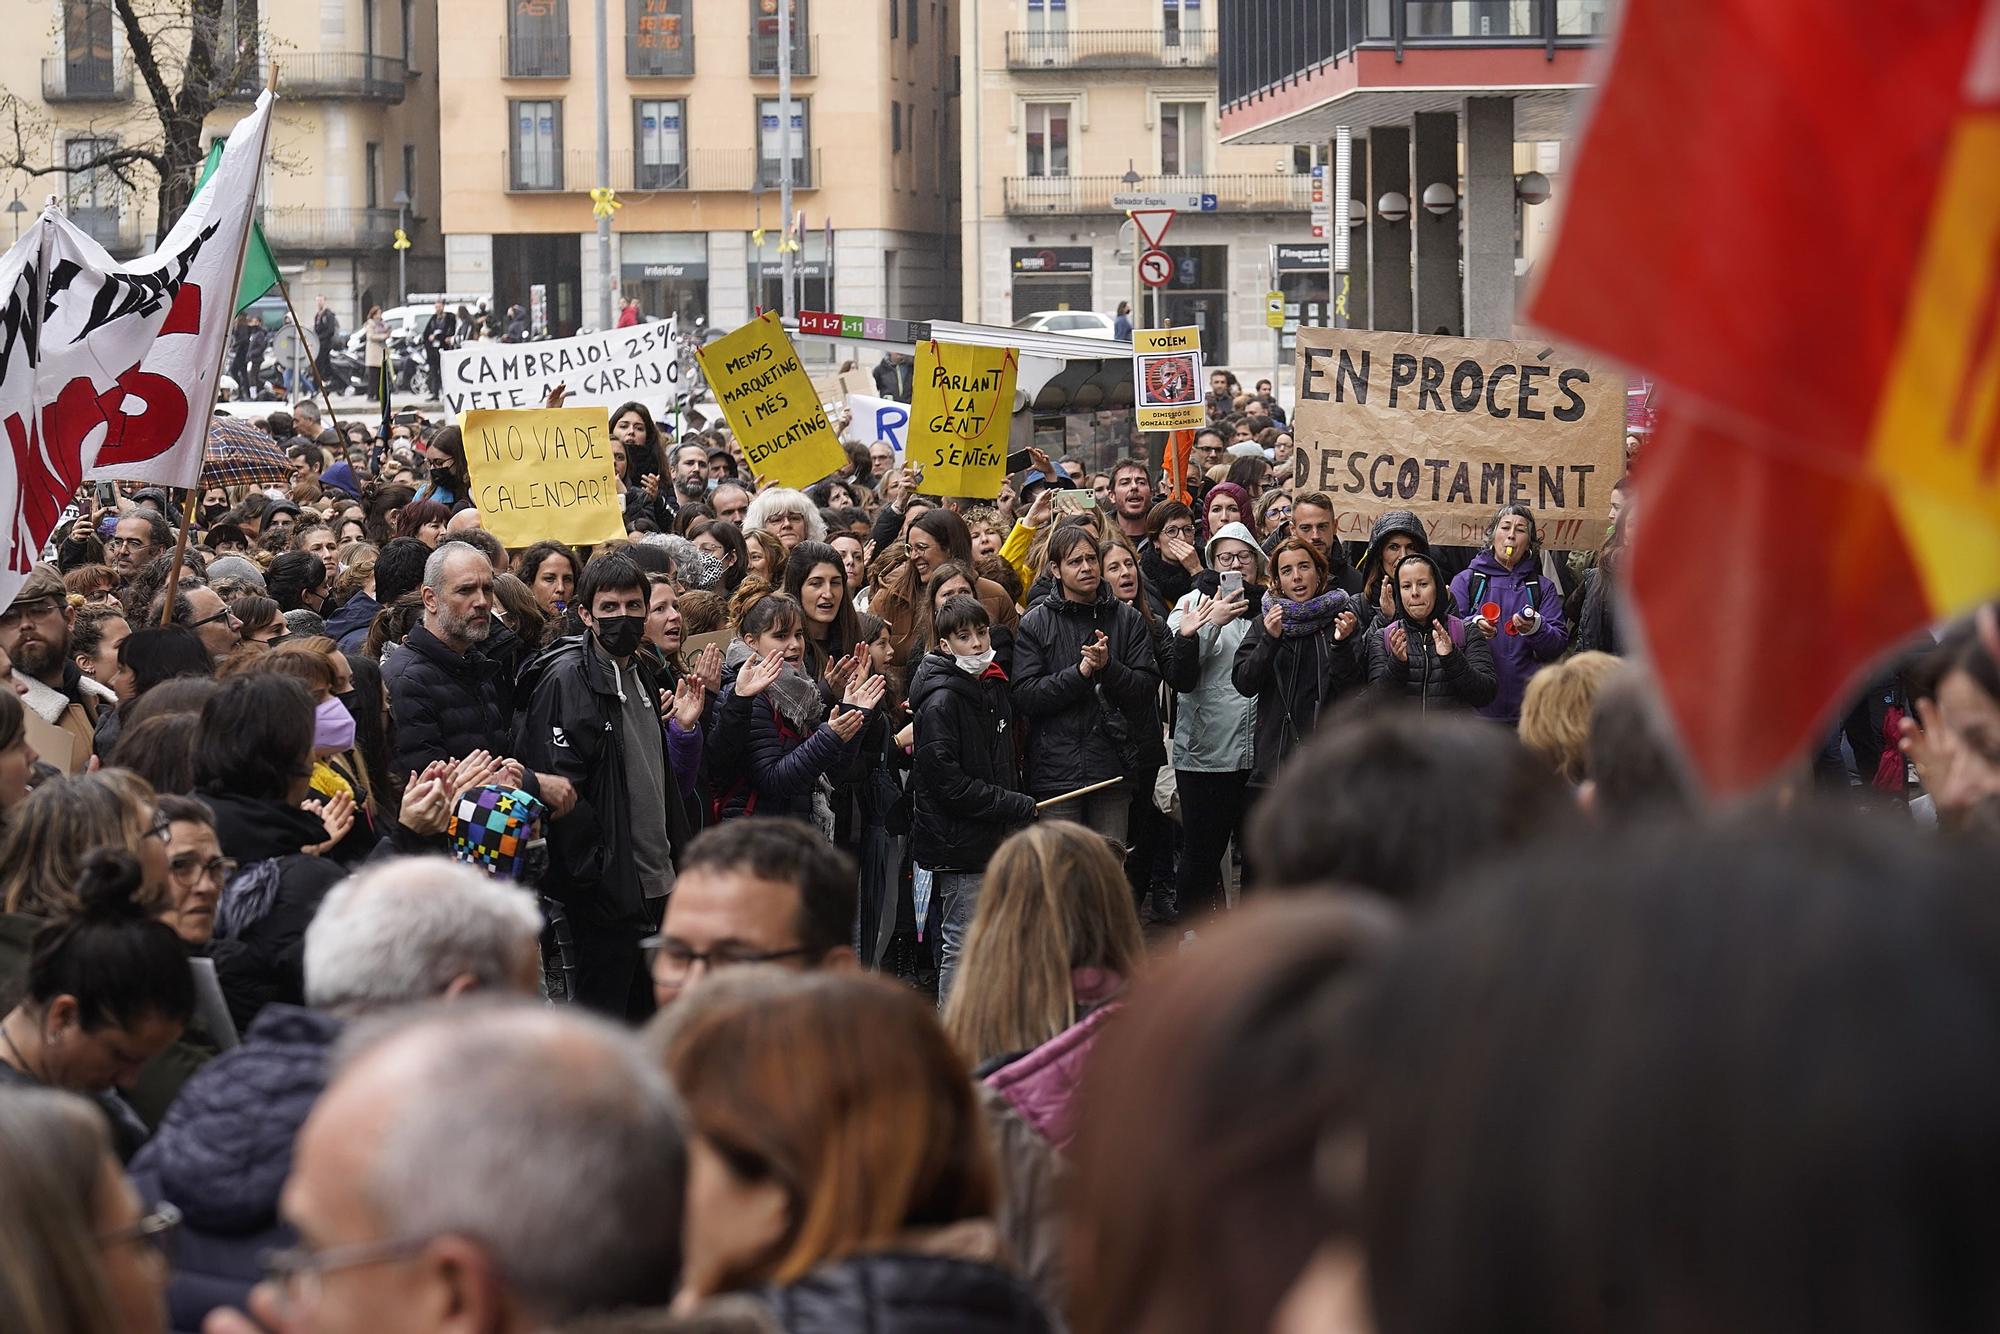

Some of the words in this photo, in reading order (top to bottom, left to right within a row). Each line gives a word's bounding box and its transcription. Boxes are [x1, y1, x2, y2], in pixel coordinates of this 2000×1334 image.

[1114, 197, 1143, 206] Salvador
[802, 317, 817, 328] L-1
[823, 318, 839, 329] L-7
[842, 321, 863, 332] L-11
[865, 323, 884, 335] L-6
[457, 340, 612, 384] CAMBRAJO!
[625, 322, 677, 359] 25%
[1149, 336, 1187, 347] VOLEM
[725, 343, 773, 375] MENYS
[446, 388, 526, 415] VETE
[584, 360, 679, 395] CARAJO
[932, 366, 1003, 393] PARLANT
[1301, 346, 1371, 405] EN
[1389, 347, 1590, 422] PROCÉS
[755, 392, 788, 421] MÉS
[953, 397, 975, 413] LA
[930, 415, 985, 435] GENT
[482, 425, 524, 462] NO
[933, 443, 1001, 467] S'ENTÉN
[1295, 441, 1595, 510] D'ESGOTAMENT
